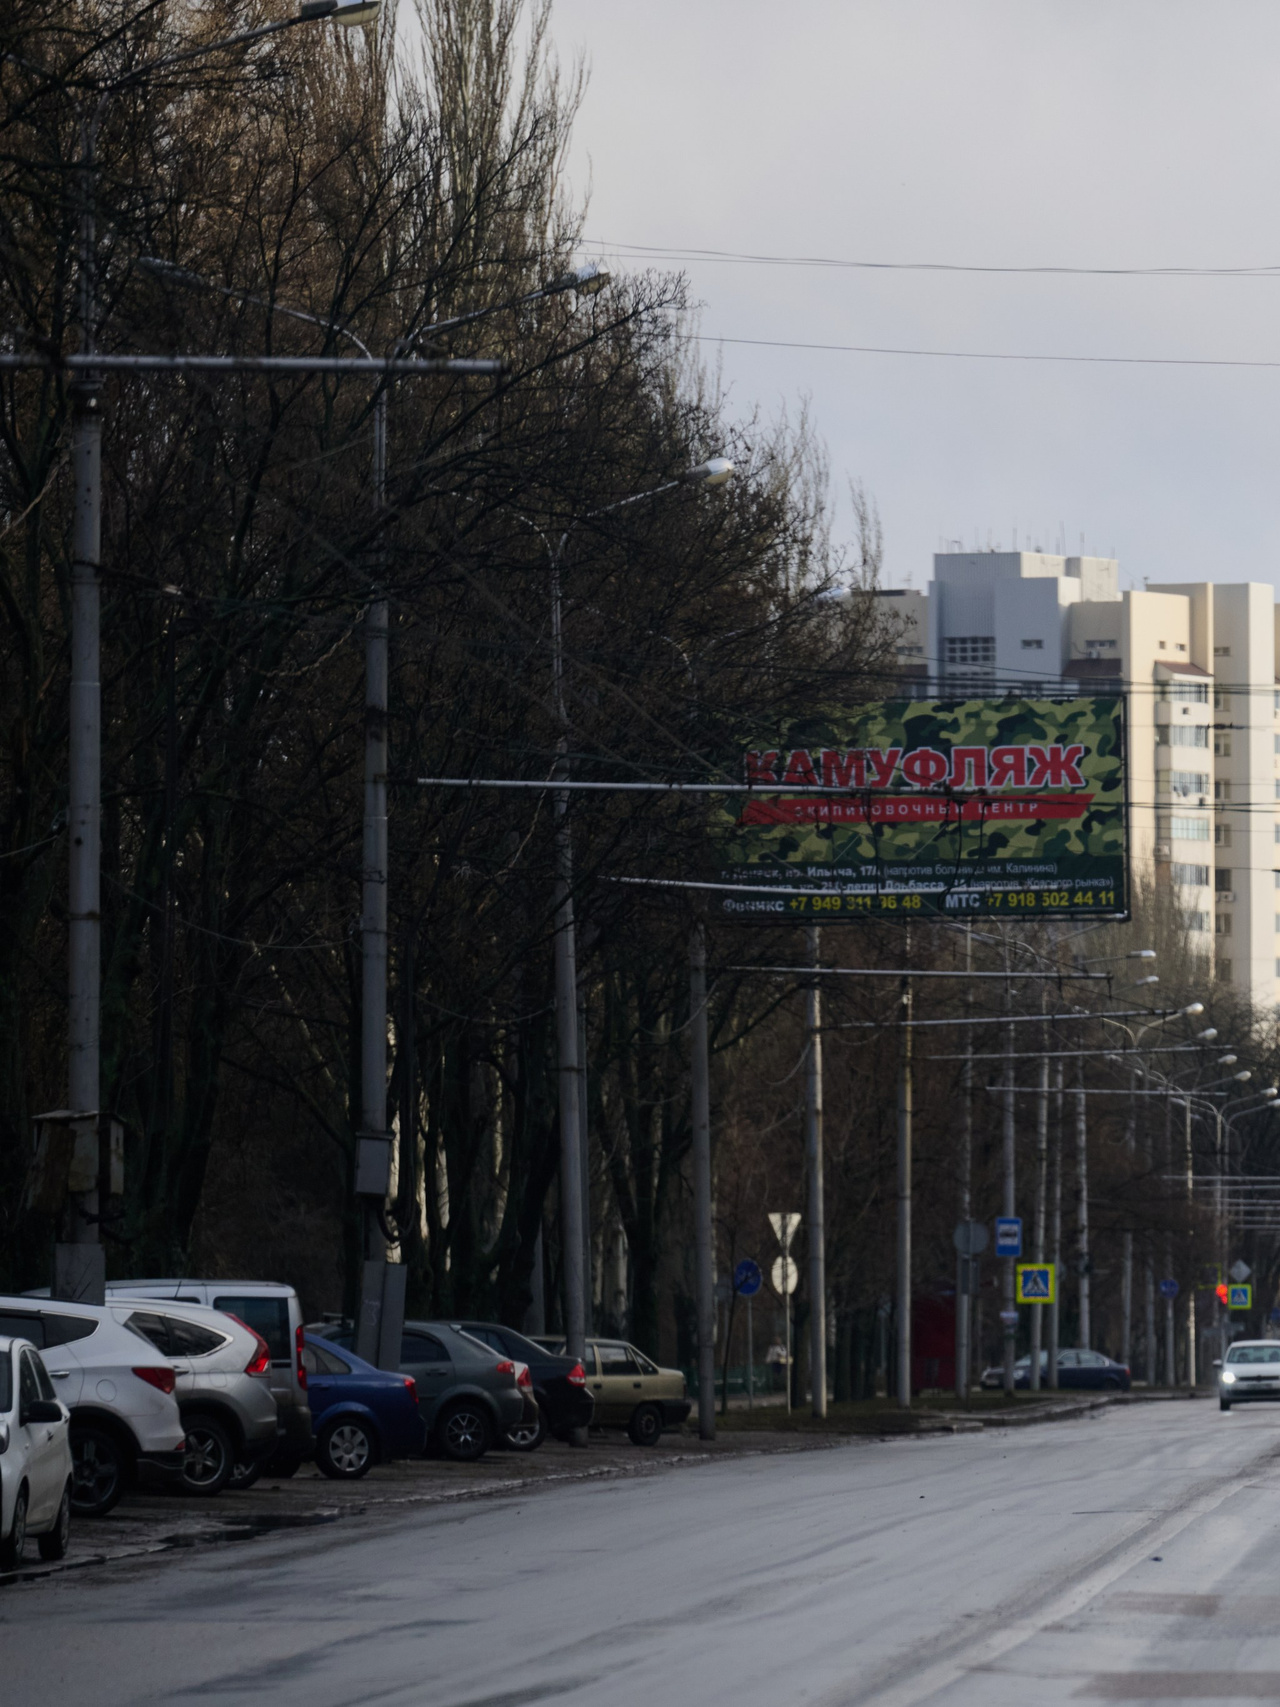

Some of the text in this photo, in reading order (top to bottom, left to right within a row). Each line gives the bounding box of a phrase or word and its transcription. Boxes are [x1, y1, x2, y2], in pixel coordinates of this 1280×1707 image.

[744, 744, 1086, 788] КАМУФЛЯЖ
[978, 802, 1039, 816] ЦЕНТР
[1006, 861, 1058, 875] Калинина)
[789, 897, 808, 911] +7
[811, 896, 842, 911] 949
[901, 894, 922, 910] 48
[945, 893, 981, 909] МТС
[985, 893, 1003, 908] +7
[1008, 892, 1036, 907] 918
[1041, 891, 1070, 907] 502
[1073, 890, 1094, 906] 44
[1099, 890, 1115, 906] 11
